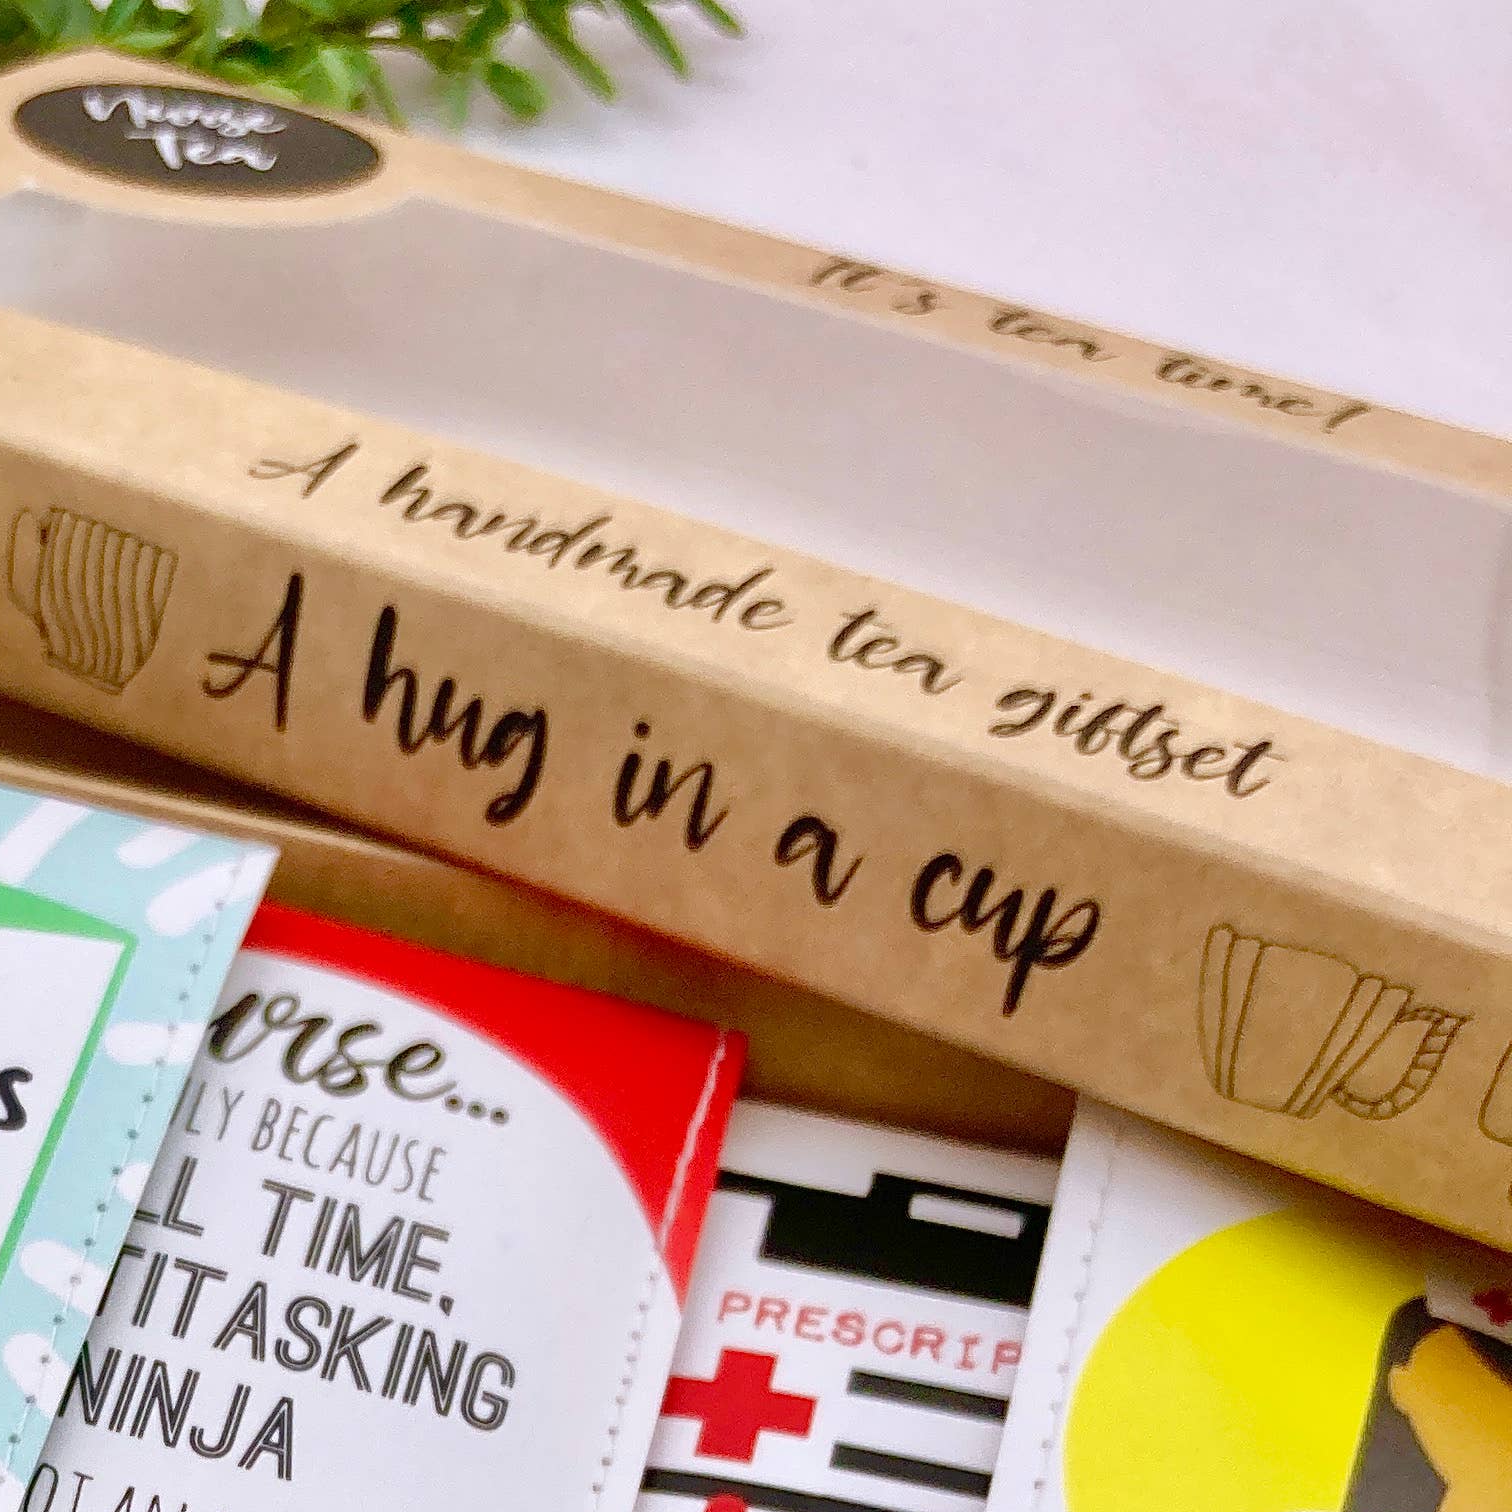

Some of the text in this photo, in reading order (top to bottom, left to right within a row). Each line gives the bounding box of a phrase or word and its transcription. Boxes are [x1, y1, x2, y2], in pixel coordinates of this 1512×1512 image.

[125, 123, 279, 171] Tea
[988, 304, 1120, 362] tea
[1155, 353, 1371, 434] time!
[246, 438, 1278, 799] A handmade tea giftset
[200, 572, 1103, 1018] A hug in a cup
[251, 1097, 447, 1202] BECAUSE
[716, 1290, 1023, 1375] PRESCRIP
[58, 1341, 295, 1482] NINJA
